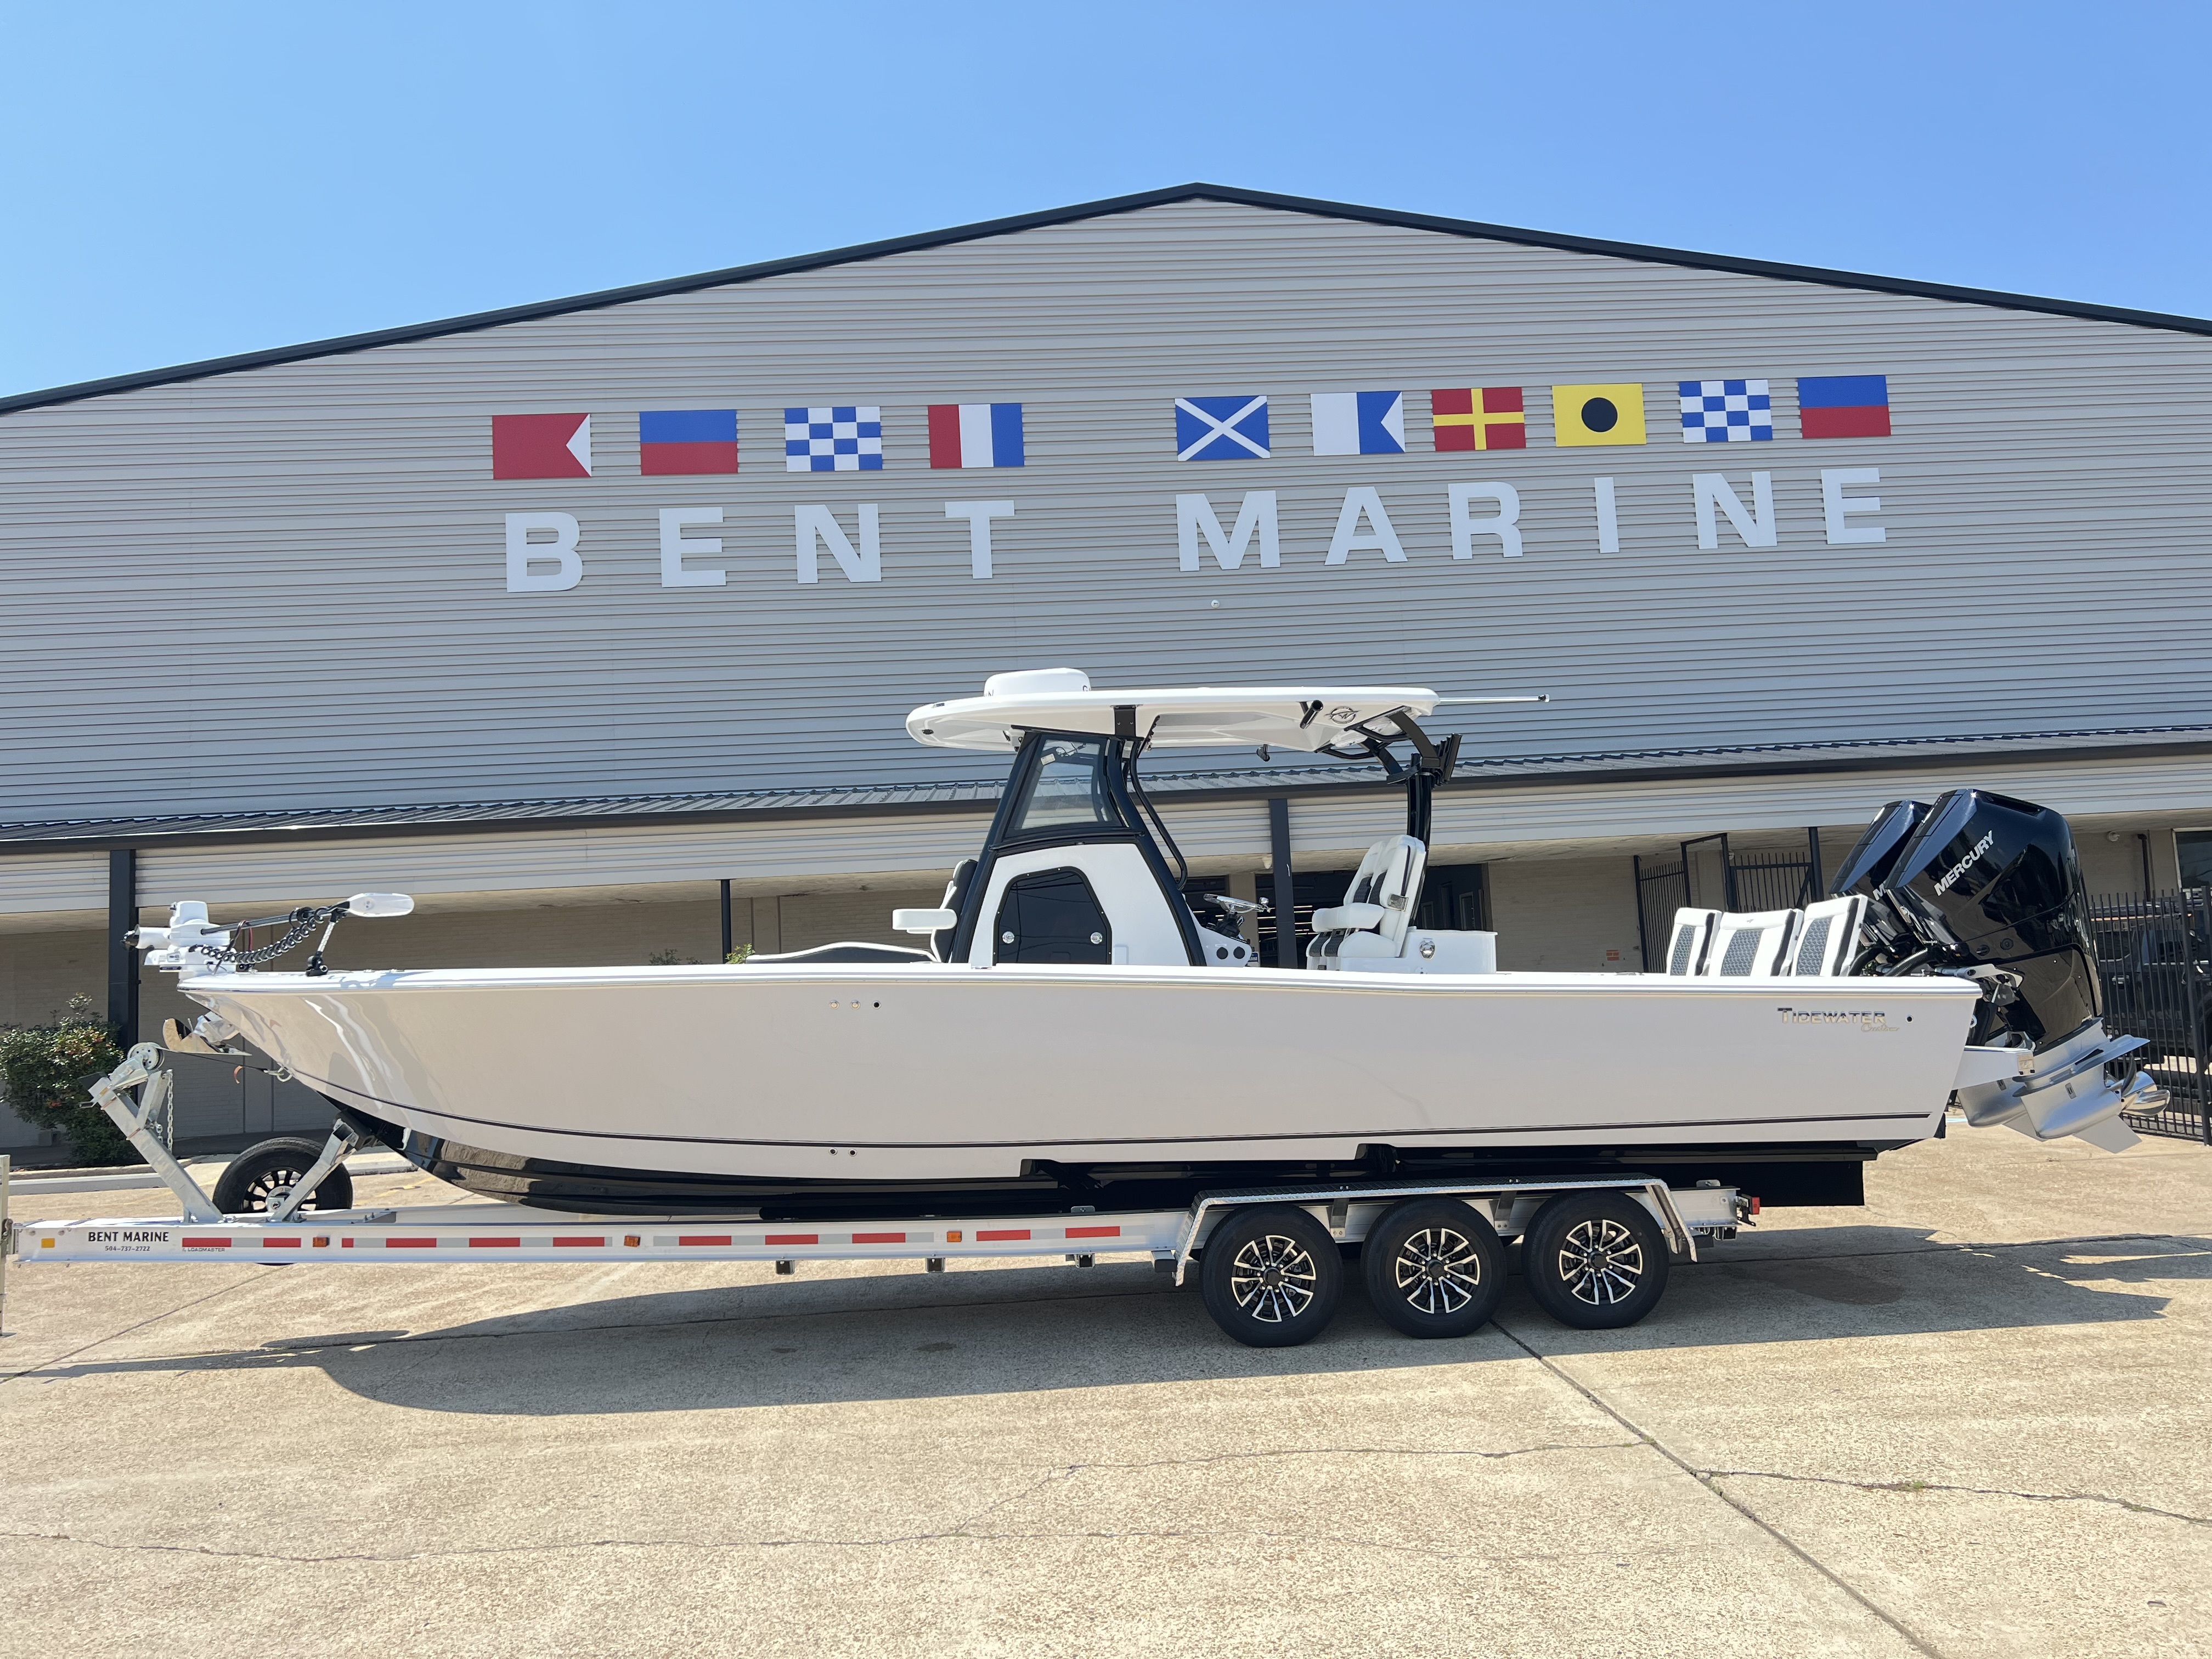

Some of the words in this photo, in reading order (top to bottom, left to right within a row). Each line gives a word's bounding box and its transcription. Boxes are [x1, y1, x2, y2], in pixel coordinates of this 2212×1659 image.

[504, 500, 1015, 592] BENT
[1175, 467, 1887, 572] MARINE
[1933, 830, 1994, 896] MERCURY
[1777, 1007, 1886, 1024] TIDEWATER
[88, 1231, 119, 1242] BENT
[123, 1231, 170, 1242] MARINE
